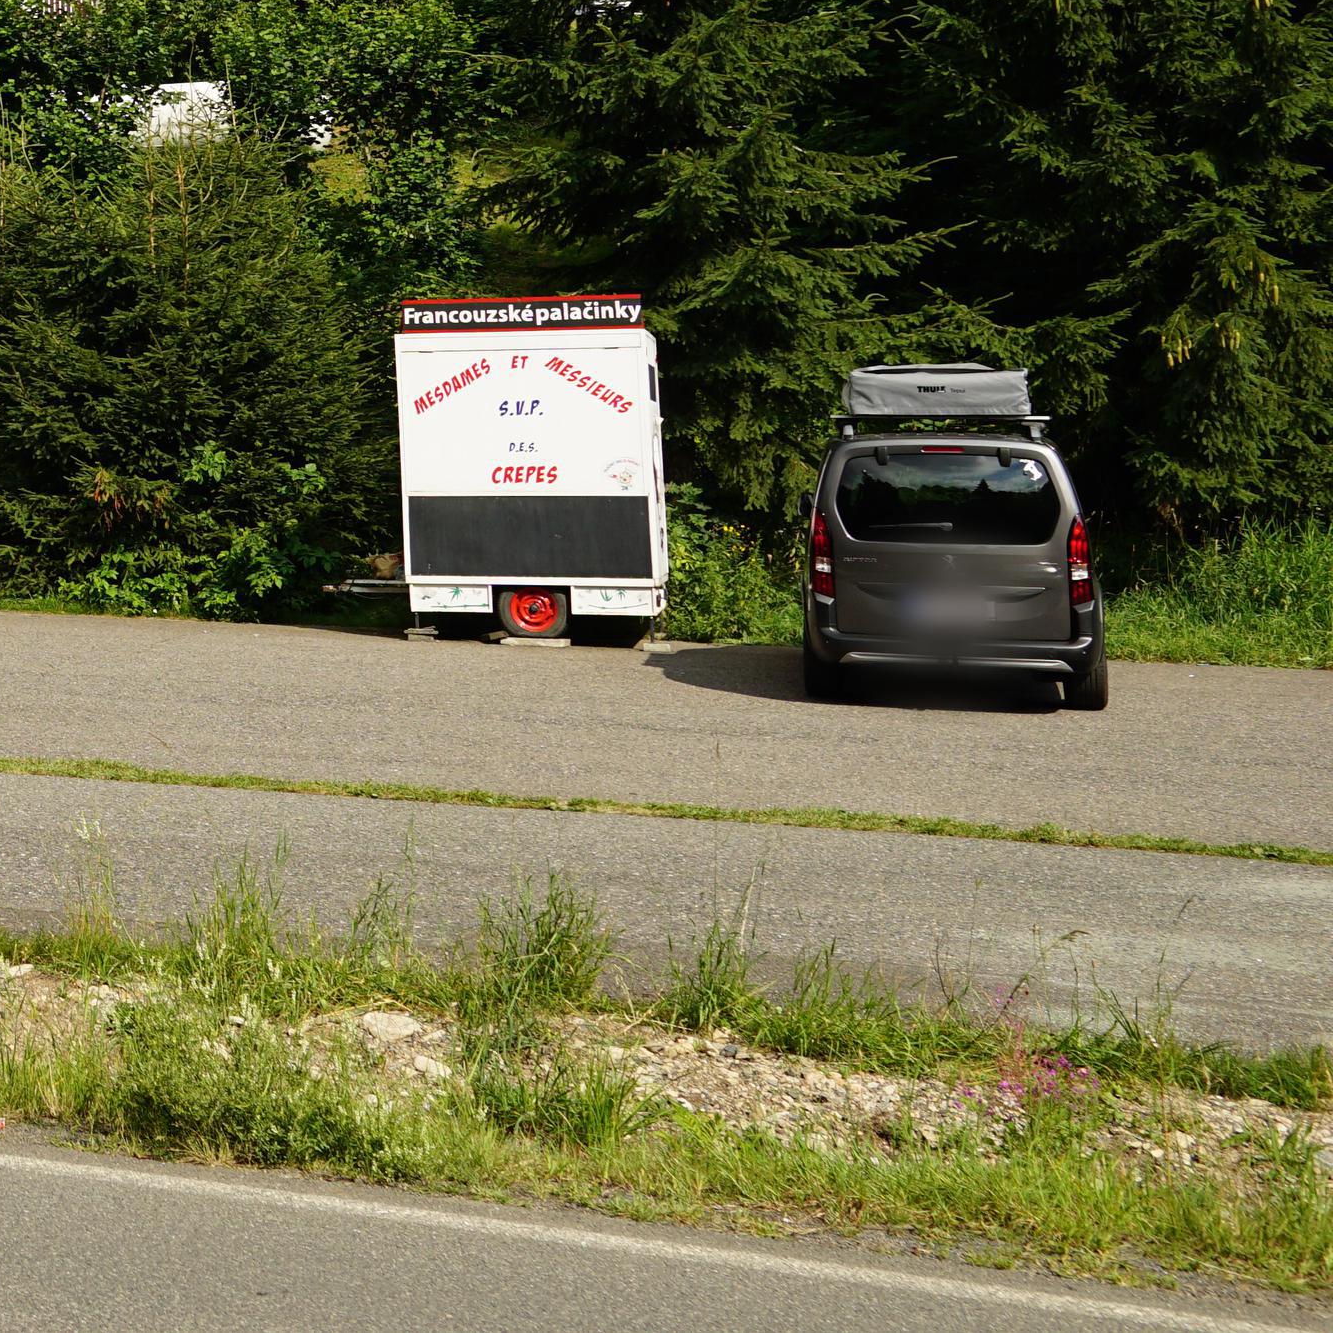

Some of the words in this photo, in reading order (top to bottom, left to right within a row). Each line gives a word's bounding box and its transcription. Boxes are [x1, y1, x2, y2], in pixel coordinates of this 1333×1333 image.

[404, 303, 533, 325] Francouzské
[535, 300, 641, 326] palačinky
[414, 357, 491, 415] MESDAMES
[511, 355, 529, 369] ET
[544, 356, 634, 415] MESSIEURS
[916, 385, 946, 394] THULE
[498, 399, 543, 417] S.V.P.
[491, 465, 558, 484] CREPES
